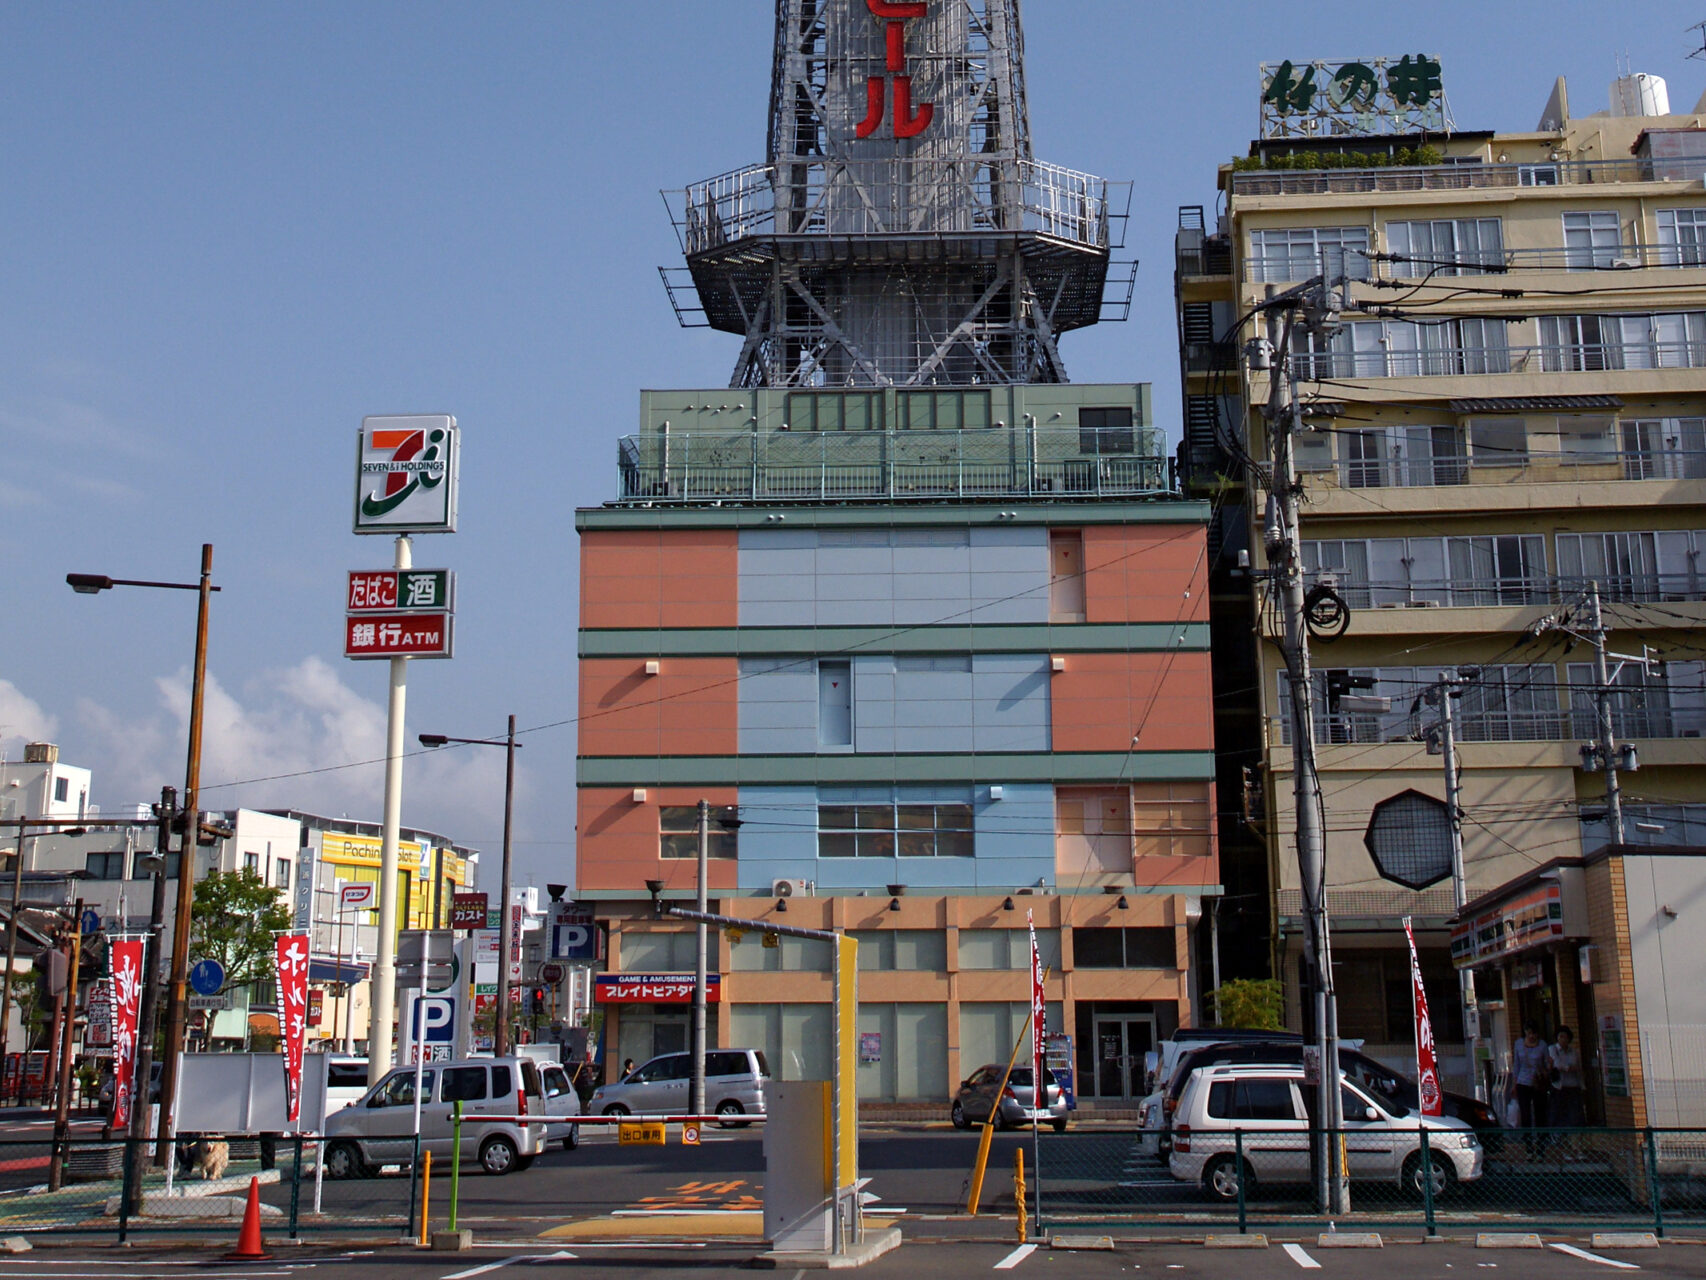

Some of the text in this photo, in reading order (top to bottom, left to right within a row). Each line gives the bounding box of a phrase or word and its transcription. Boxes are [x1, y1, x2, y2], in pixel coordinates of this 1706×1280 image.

[401, 461, 445, 471] HOLDINGS
[350, 574, 437, 607] たばこ 酒
[343, 841, 382, 859] Pachin
[455, 910, 485, 921] ガスト
[558, 925, 588, 957] P
[422, 999, 452, 1040] P
[622, 1130, 661, 1141] 出口専用
